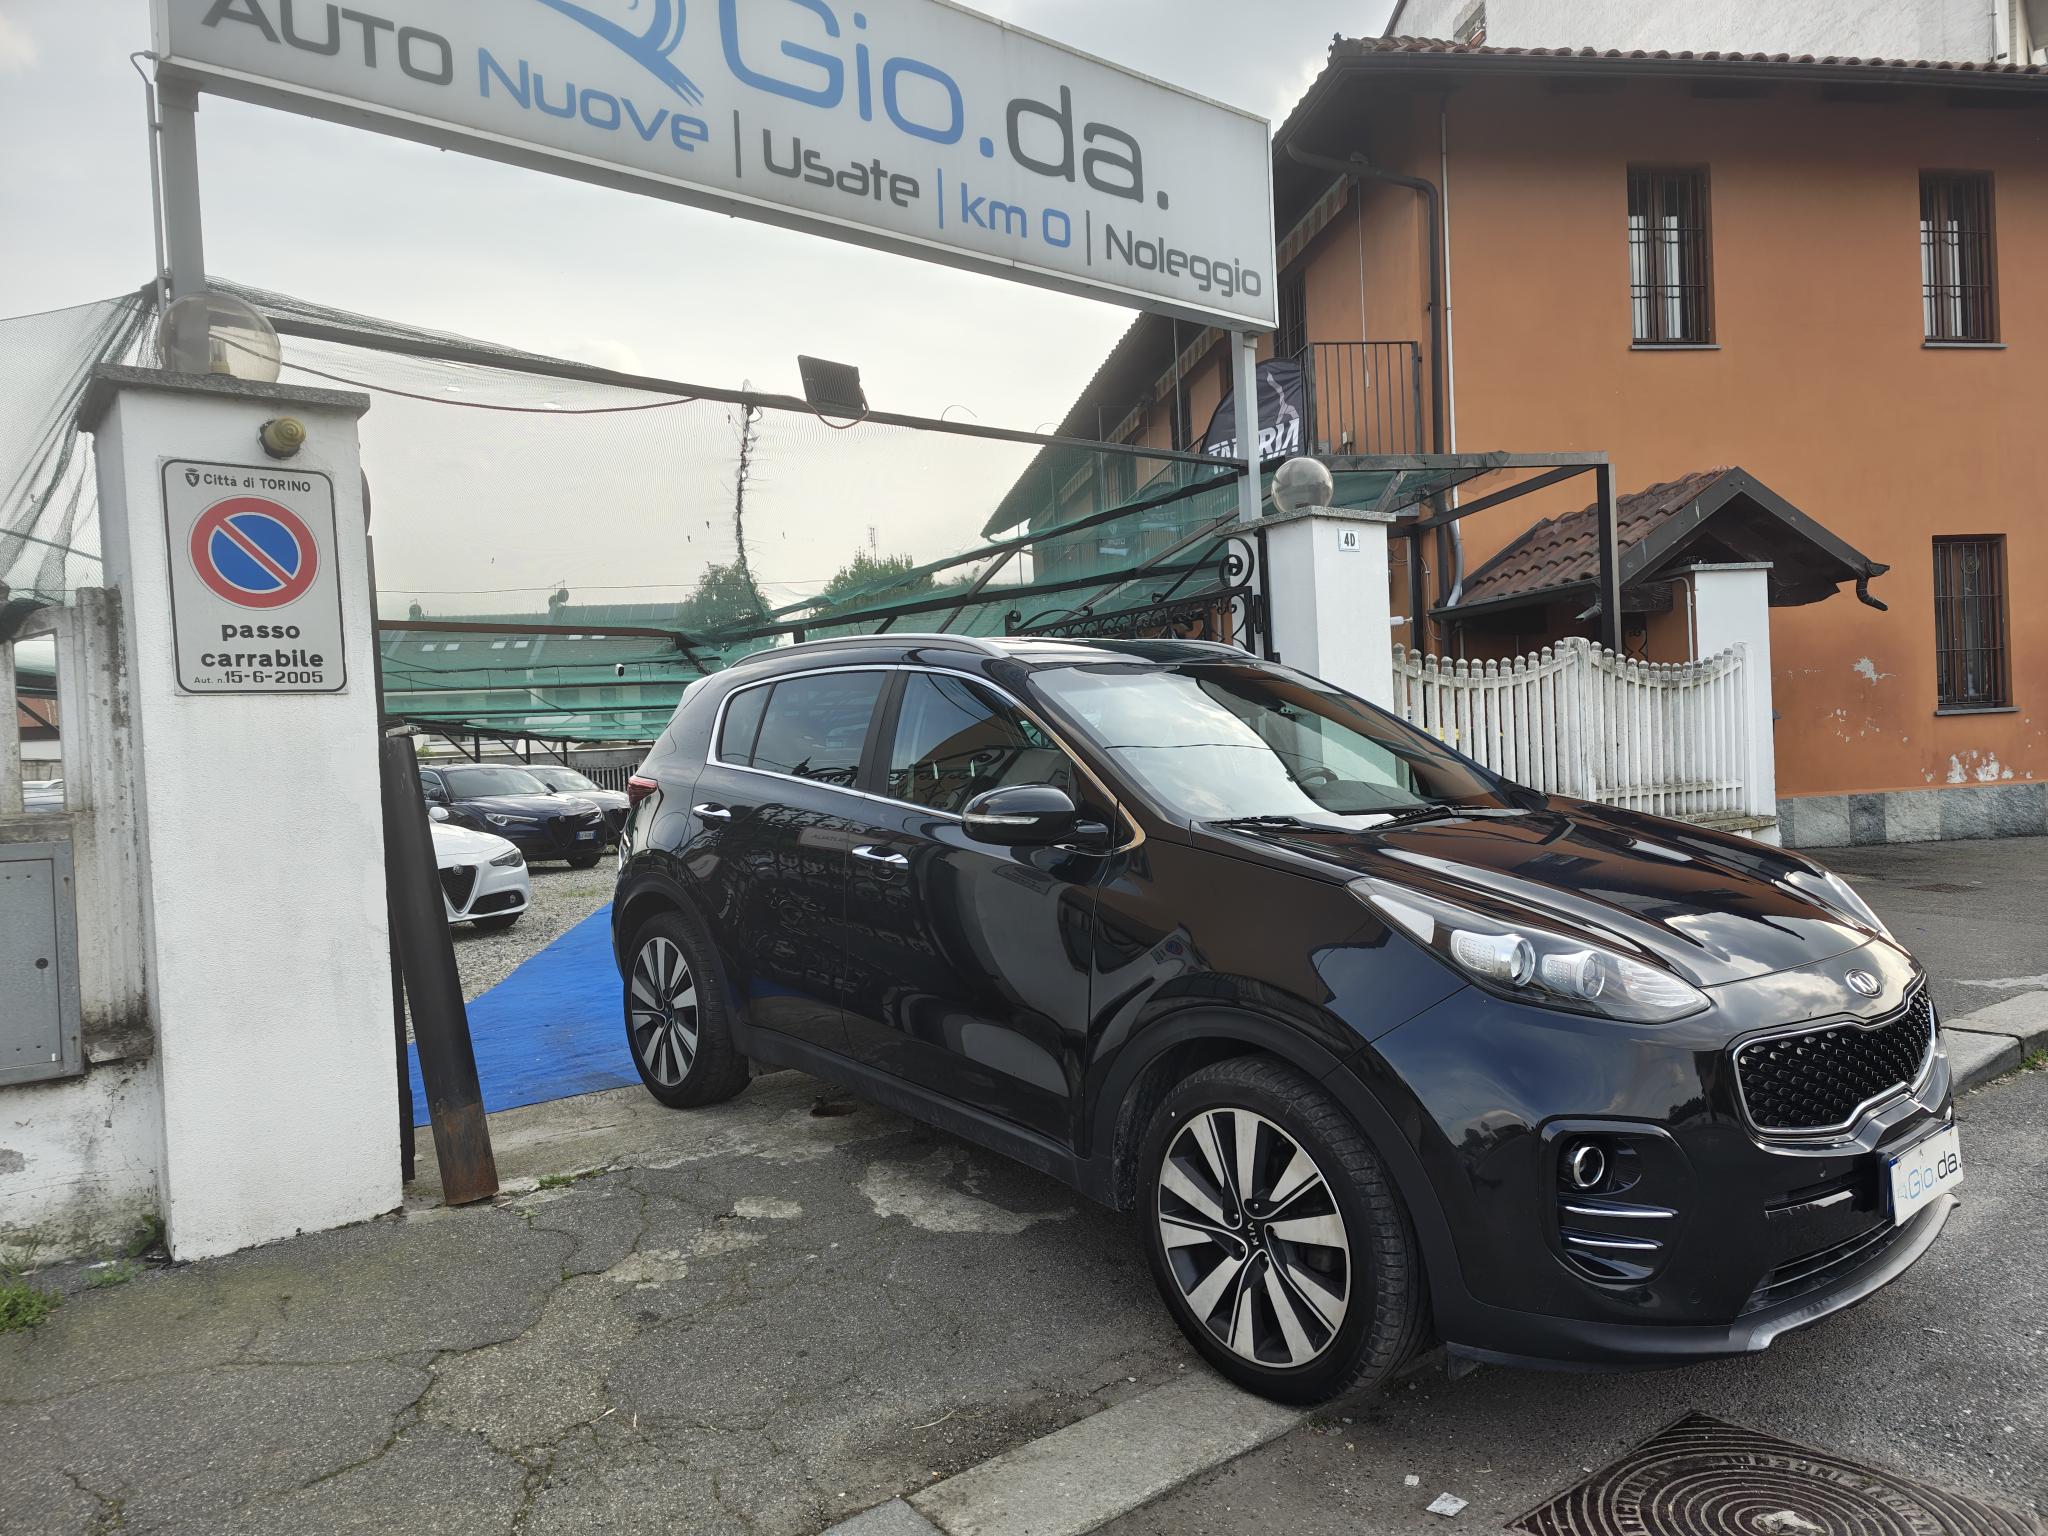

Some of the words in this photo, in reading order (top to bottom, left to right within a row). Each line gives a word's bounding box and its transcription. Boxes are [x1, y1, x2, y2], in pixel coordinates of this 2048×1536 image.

[201, 0, 454, 86] AUTO
[478, 48, 710, 152] Nuove
[763, 128, 920, 208] Usate
[960, 182, 1027, 239] km
[1106, 223, 1262, 298] Noleggio
[243, 477, 255, 488] di
[259, 478, 311, 492] TORINO
[1343, 532, 1356, 547] 4D
[221, 623, 300, 641] passo
[200, 649, 324, 667] carrabile
[224, 670, 323, 684] 15-6-2005
